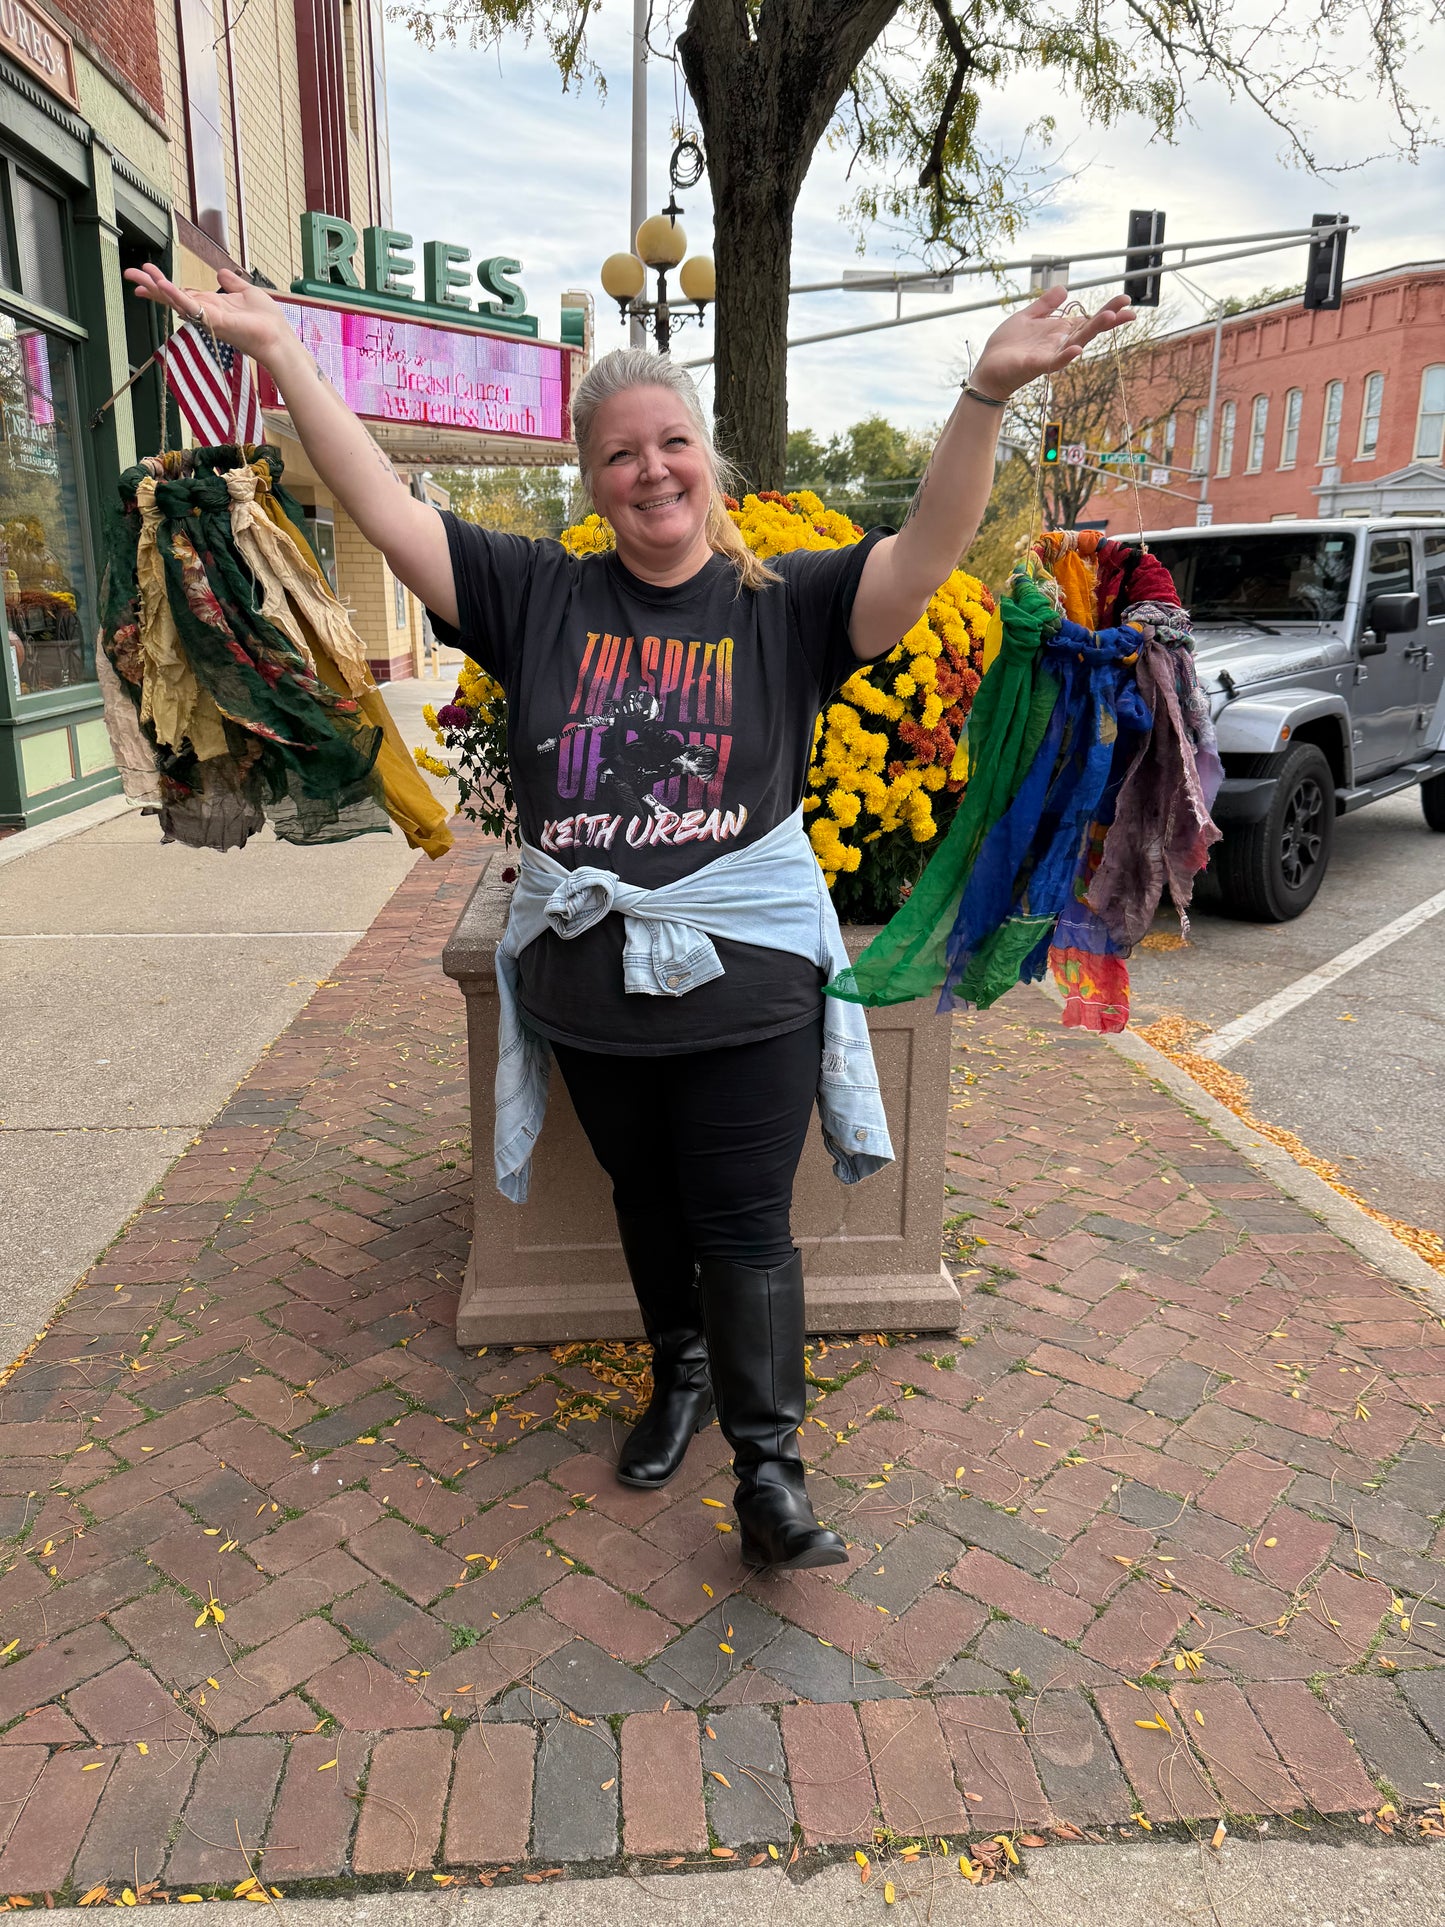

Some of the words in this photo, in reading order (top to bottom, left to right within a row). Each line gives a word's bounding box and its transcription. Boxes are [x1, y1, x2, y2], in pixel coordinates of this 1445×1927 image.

[300, 211, 527, 318] REES
[383, 390, 480, 426] Awareness
[483, 402, 535, 433] Month
[396, 365, 450, 396] Breast
[455, 372, 512, 404] Cancer
[568, 631, 635, 716] THE
[638, 635, 735, 727] SPEED
[557, 722, 610, 800] OF
[540, 812, 624, 853] KEITH
[625, 802, 748, 849] URBAN
